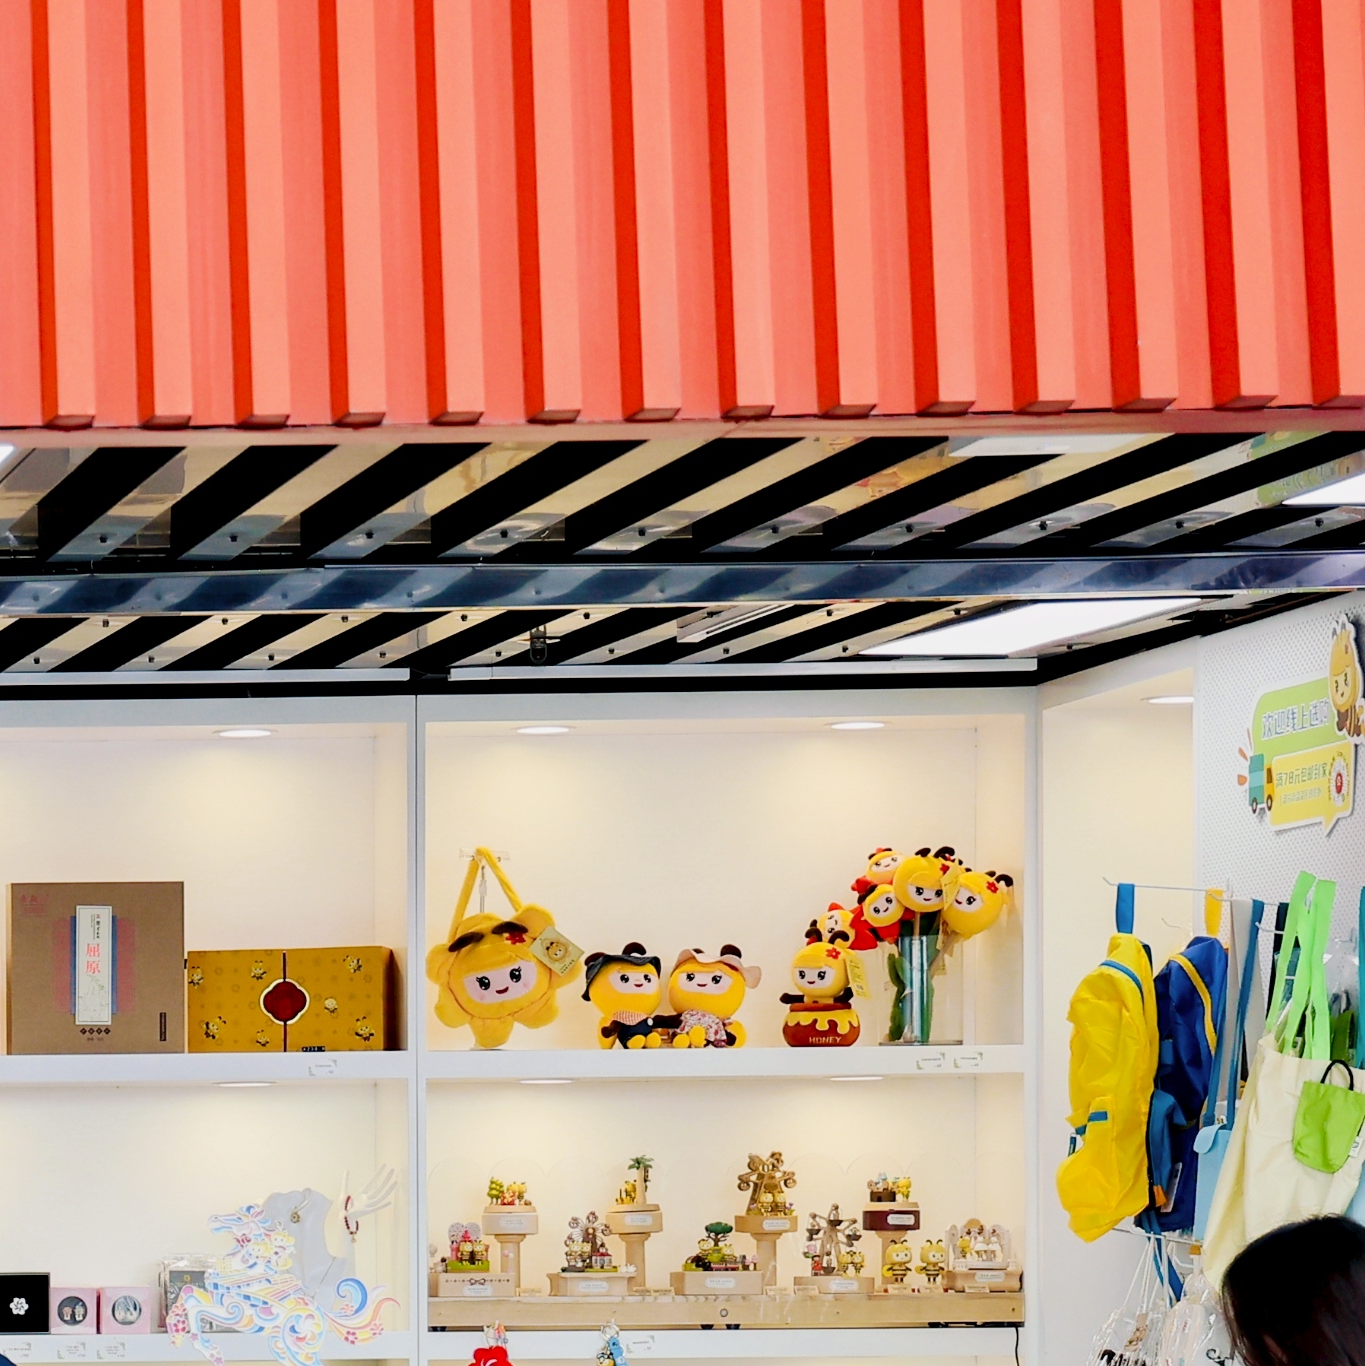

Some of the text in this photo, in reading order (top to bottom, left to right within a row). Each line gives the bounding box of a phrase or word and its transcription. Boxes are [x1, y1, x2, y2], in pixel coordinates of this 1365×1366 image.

[1261, 697, 1330, 740] 欢迎线上选购
[85, 943, 101, 974] 屈原
[809, 1036, 842, 1044] HONEY
